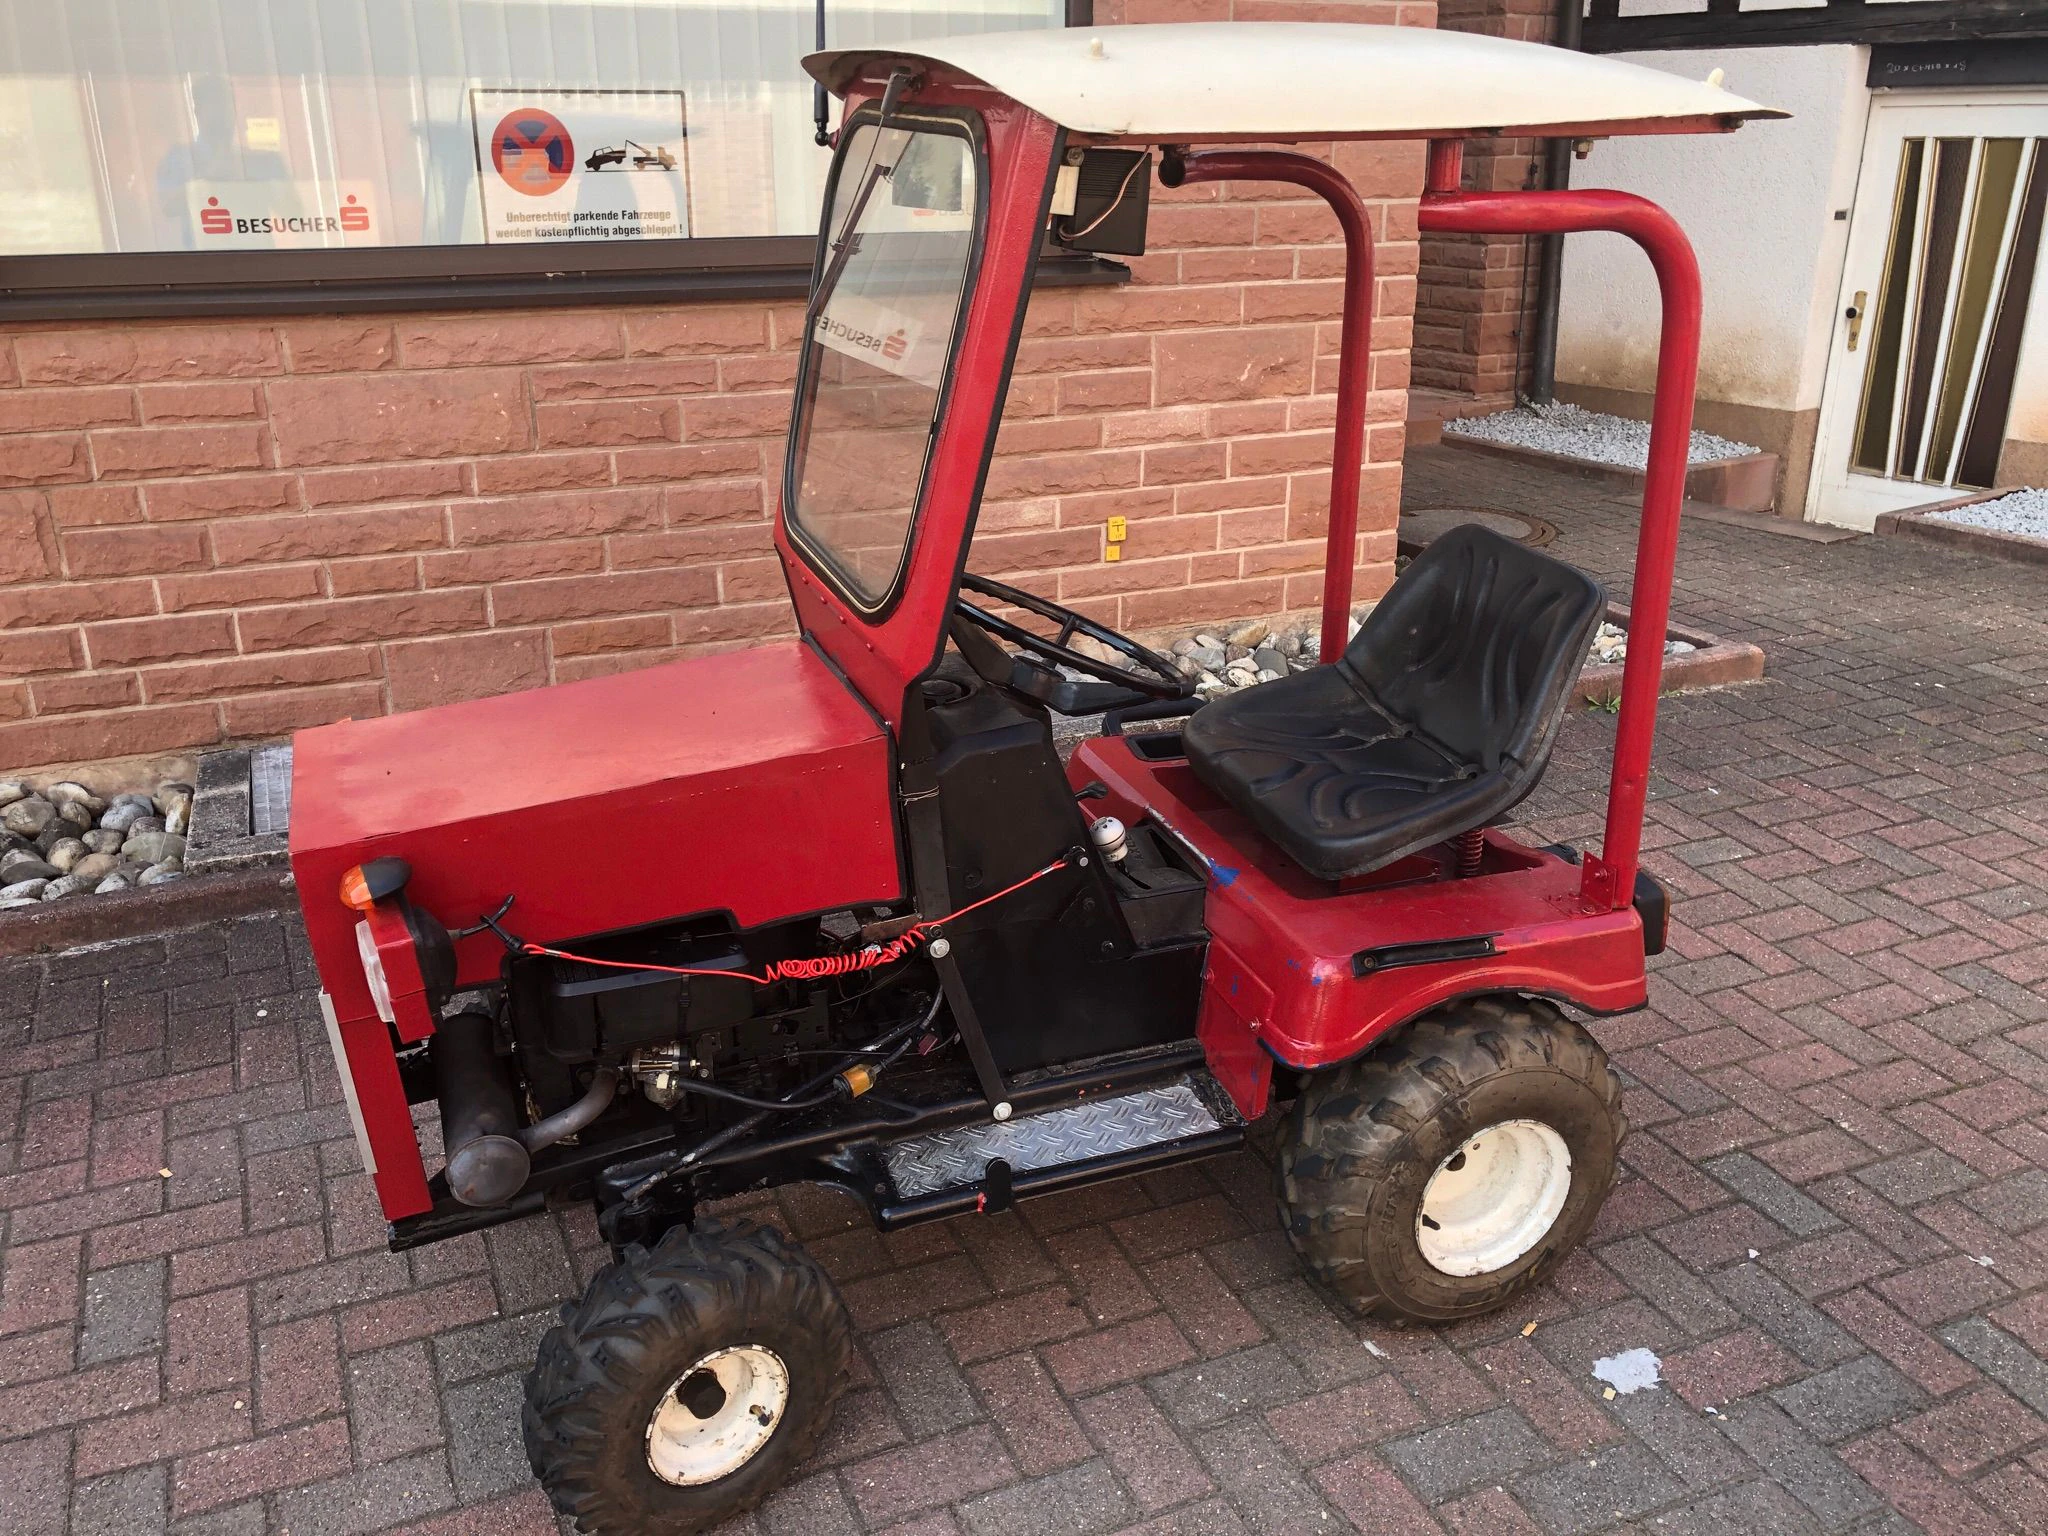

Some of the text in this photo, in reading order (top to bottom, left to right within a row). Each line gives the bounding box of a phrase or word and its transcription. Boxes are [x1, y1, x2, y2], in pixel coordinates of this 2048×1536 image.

[505, 209, 672, 223] Unberechtigt parkende Fahrzeuge
[236, 217, 340, 234] BESUCHER
[495, 227, 532, 239] werden
[535, 225, 610, 239] kostenpflichtig
[612, 224, 678, 237] abgeschleppt
